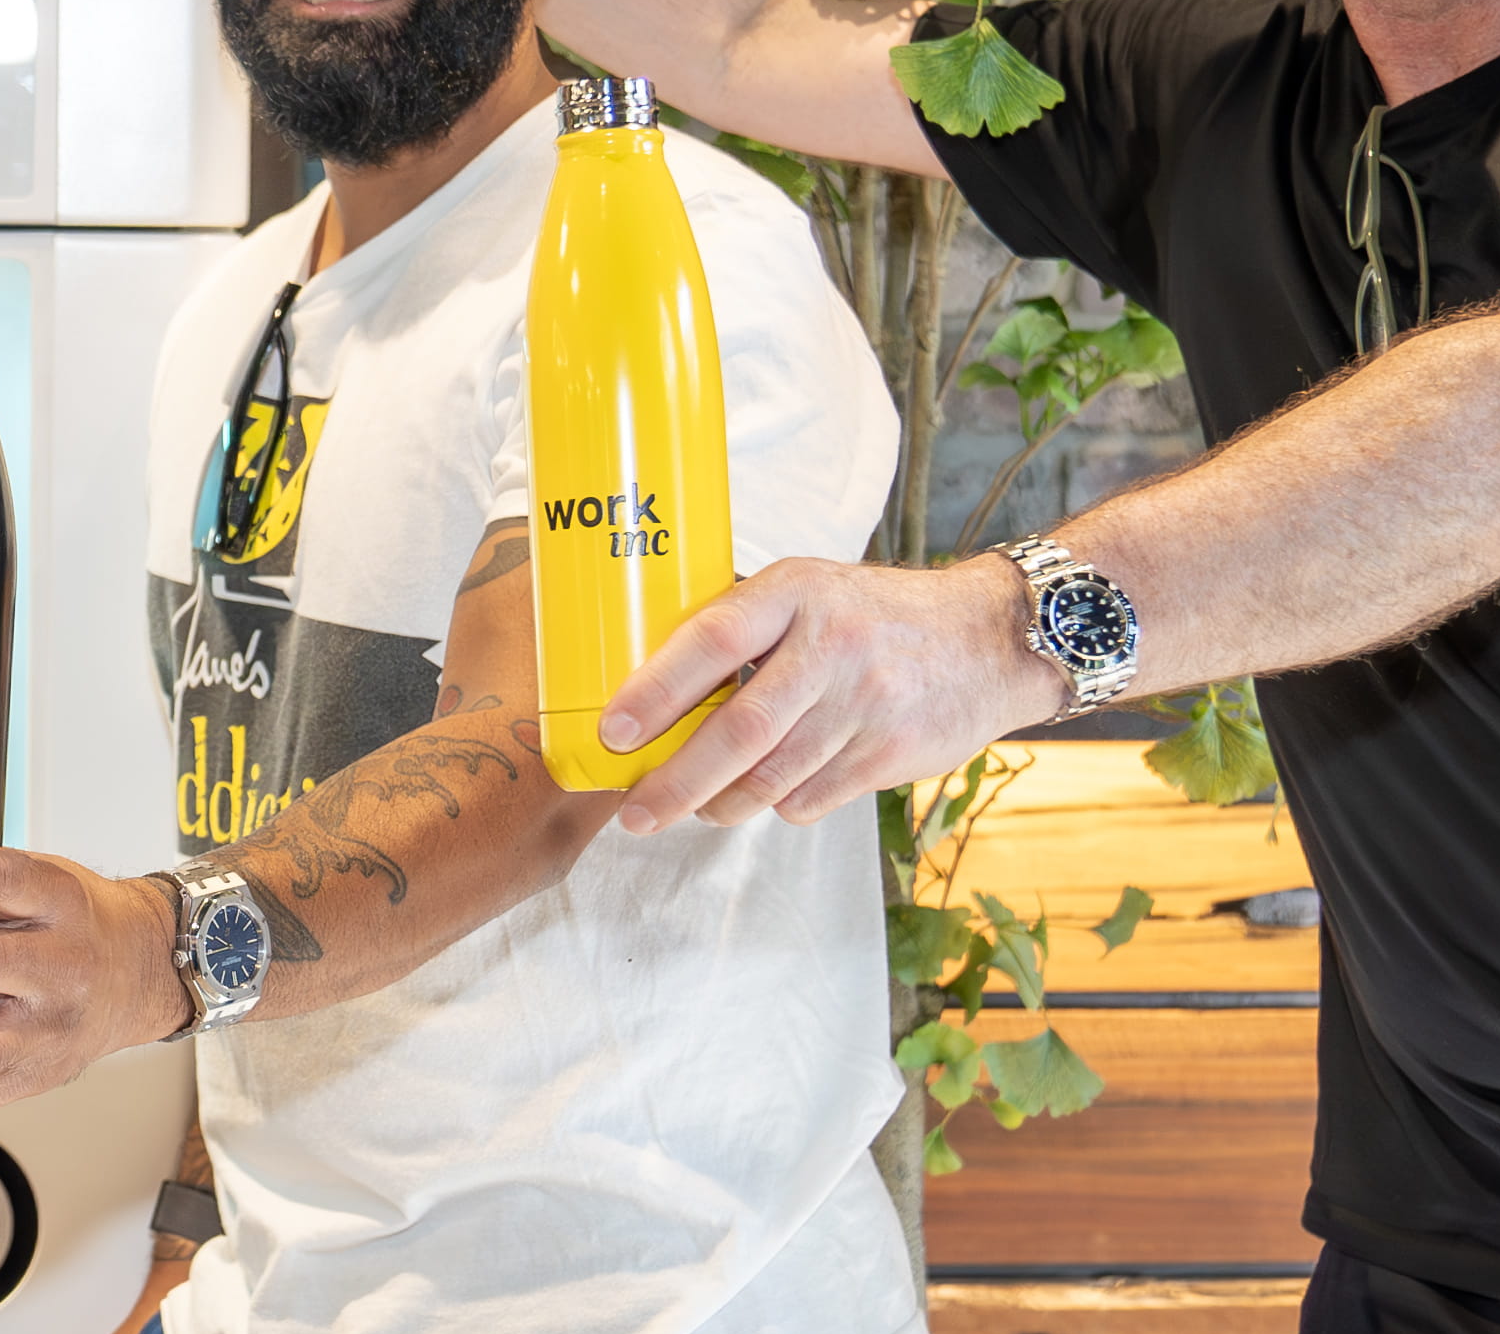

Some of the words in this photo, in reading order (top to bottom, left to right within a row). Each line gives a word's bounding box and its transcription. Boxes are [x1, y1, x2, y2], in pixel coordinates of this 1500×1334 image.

[544, 482, 661, 531] work
[609, 529, 670, 558] inc
[173, 564, 271, 700] Jane's
